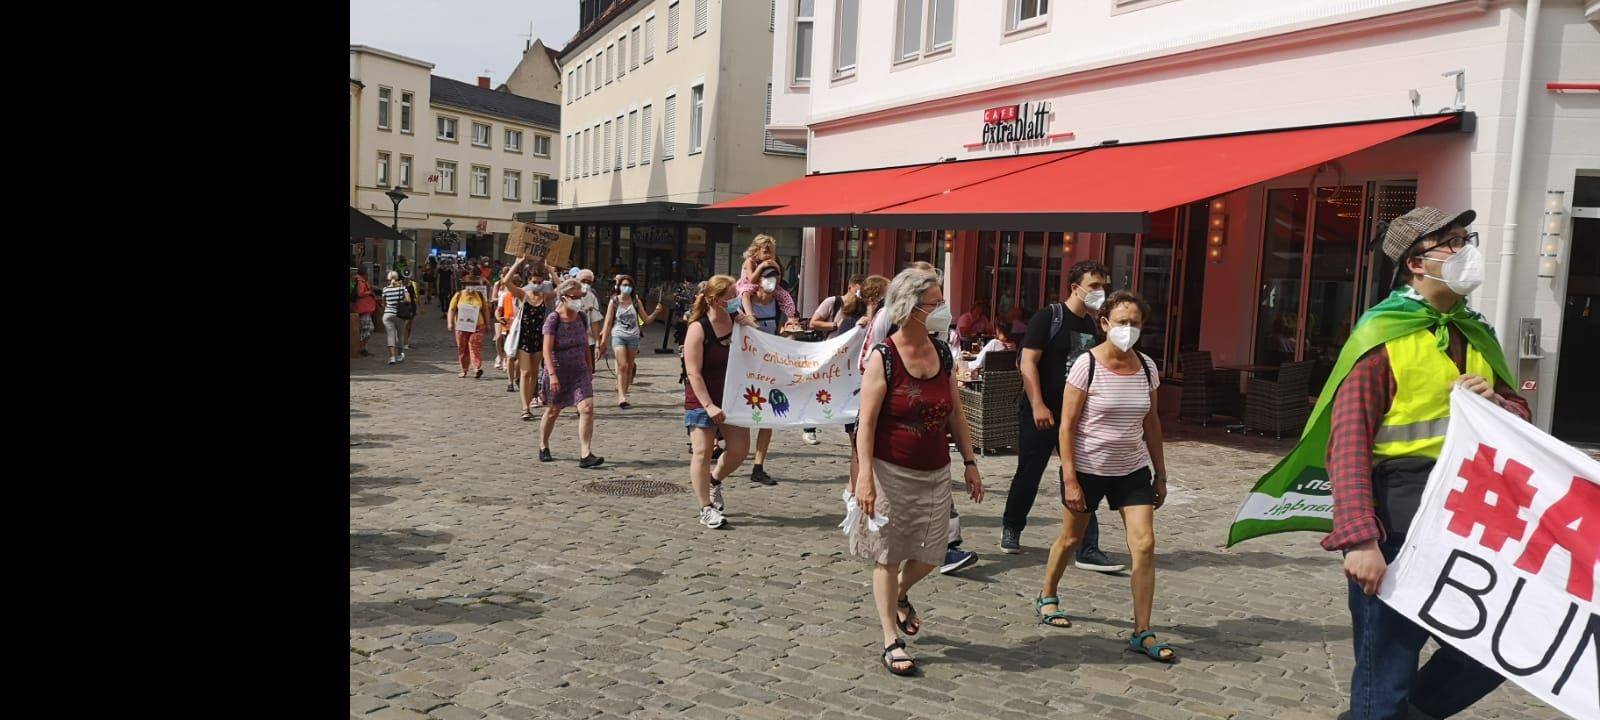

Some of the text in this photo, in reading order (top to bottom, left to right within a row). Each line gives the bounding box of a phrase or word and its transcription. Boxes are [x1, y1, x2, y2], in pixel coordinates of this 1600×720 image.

[982, 101, 1049, 145] extrablatt
[741, 335, 757, 354] Sie
[746, 371, 776, 384] unsere
